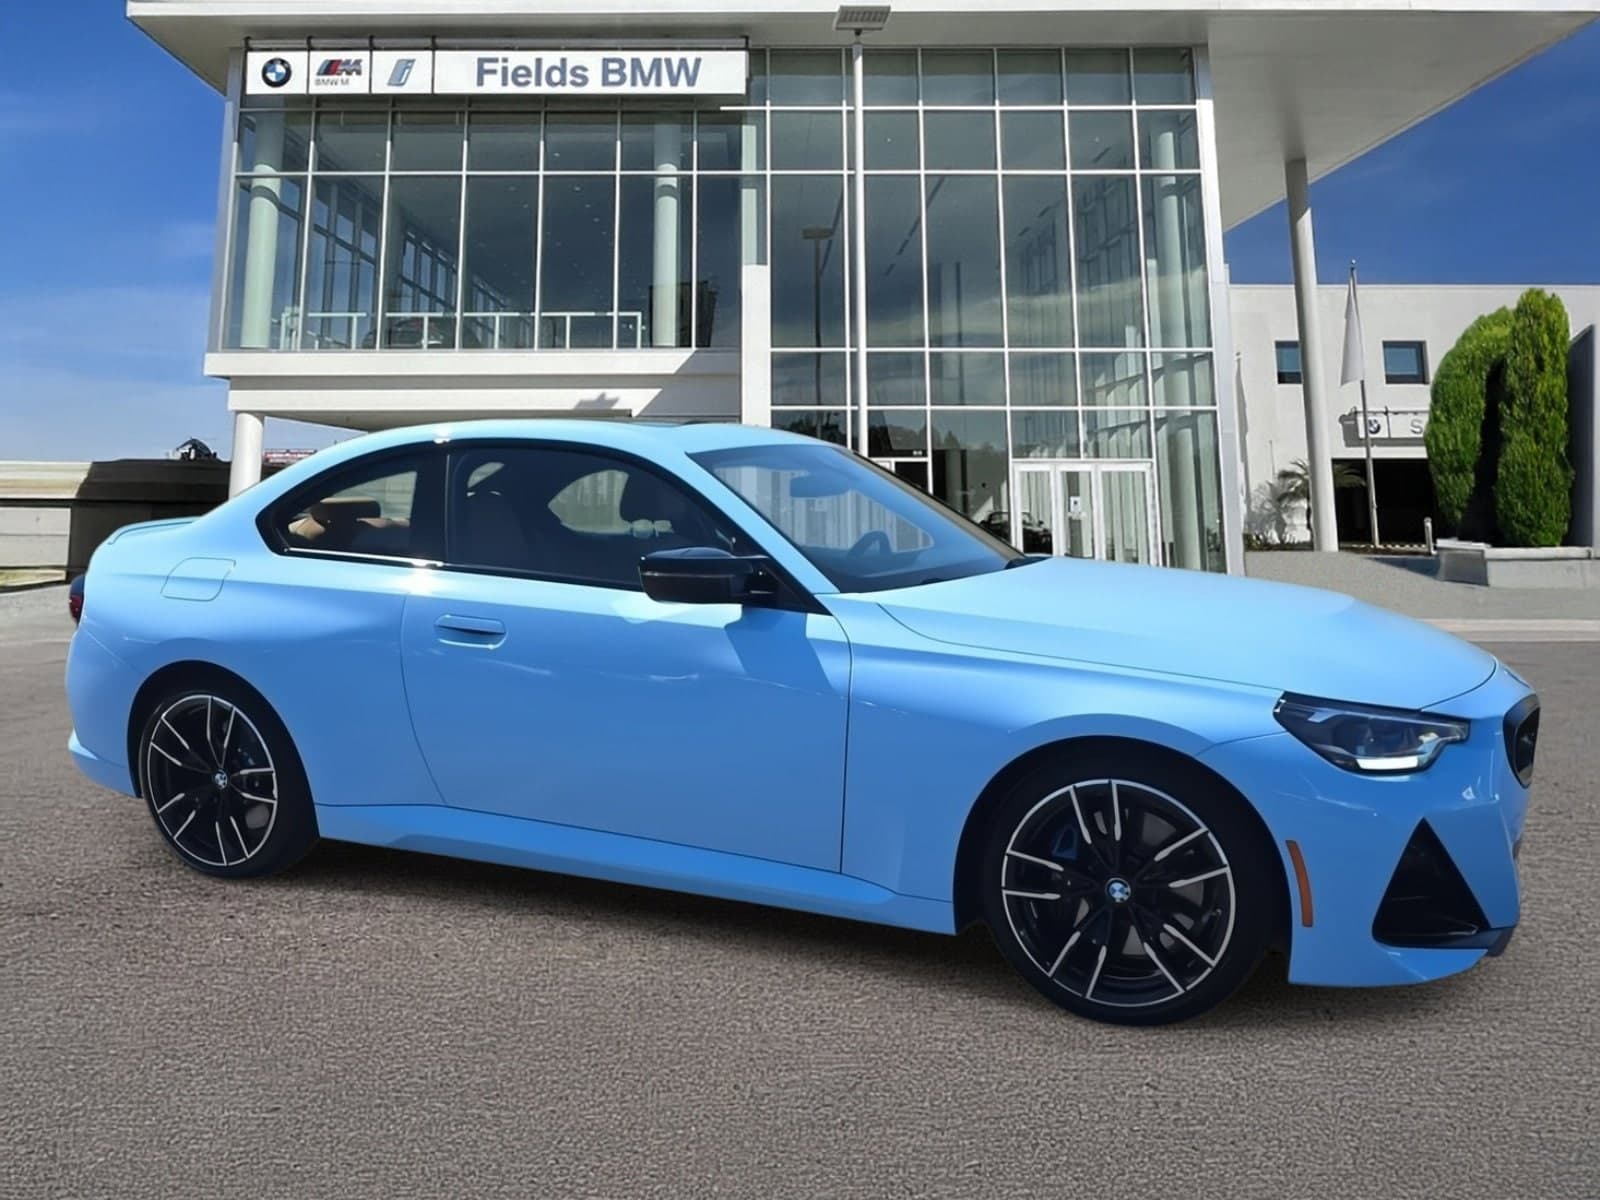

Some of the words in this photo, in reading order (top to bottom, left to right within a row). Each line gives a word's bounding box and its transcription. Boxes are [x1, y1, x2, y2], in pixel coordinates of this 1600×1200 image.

[315, 78, 339, 87] BMW
[476, 57, 589, 88] Fields
[601, 57, 702, 88] BMW
